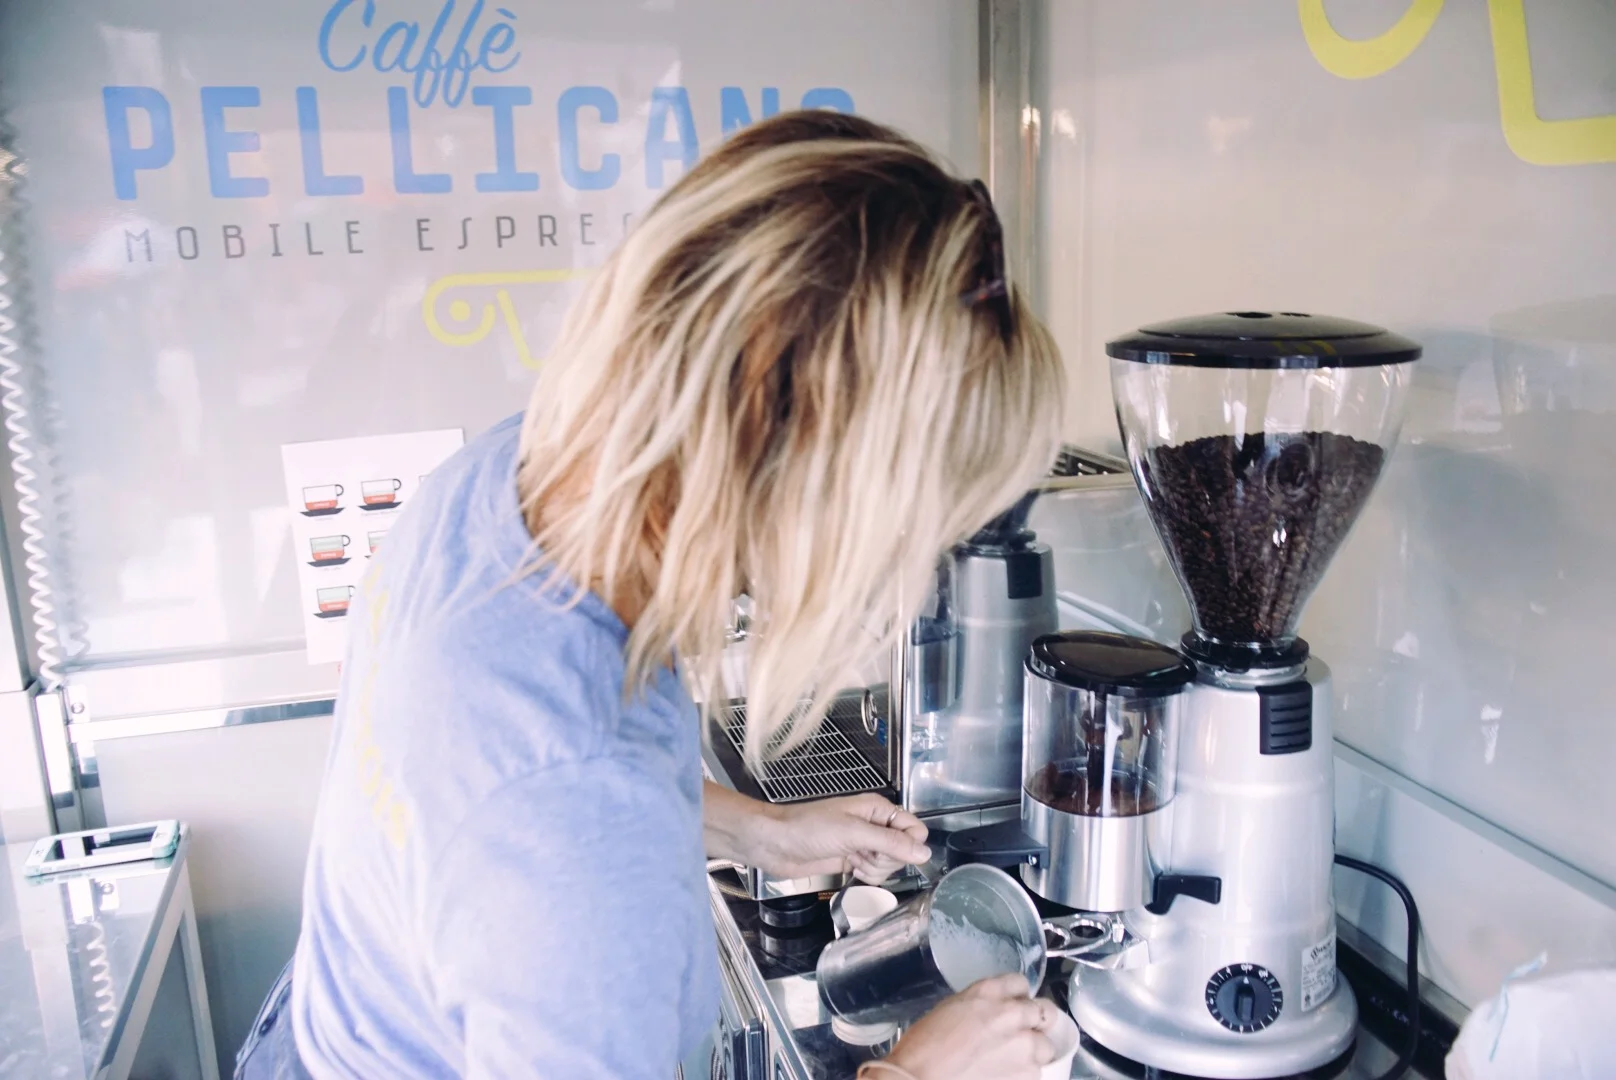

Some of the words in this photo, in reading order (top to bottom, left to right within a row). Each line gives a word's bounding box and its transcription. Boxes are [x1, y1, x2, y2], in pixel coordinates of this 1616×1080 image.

[317, 0, 522, 108] Caffè
[102, 86, 857, 200] PELLICA
[125, 220, 365, 263] MOBILE
